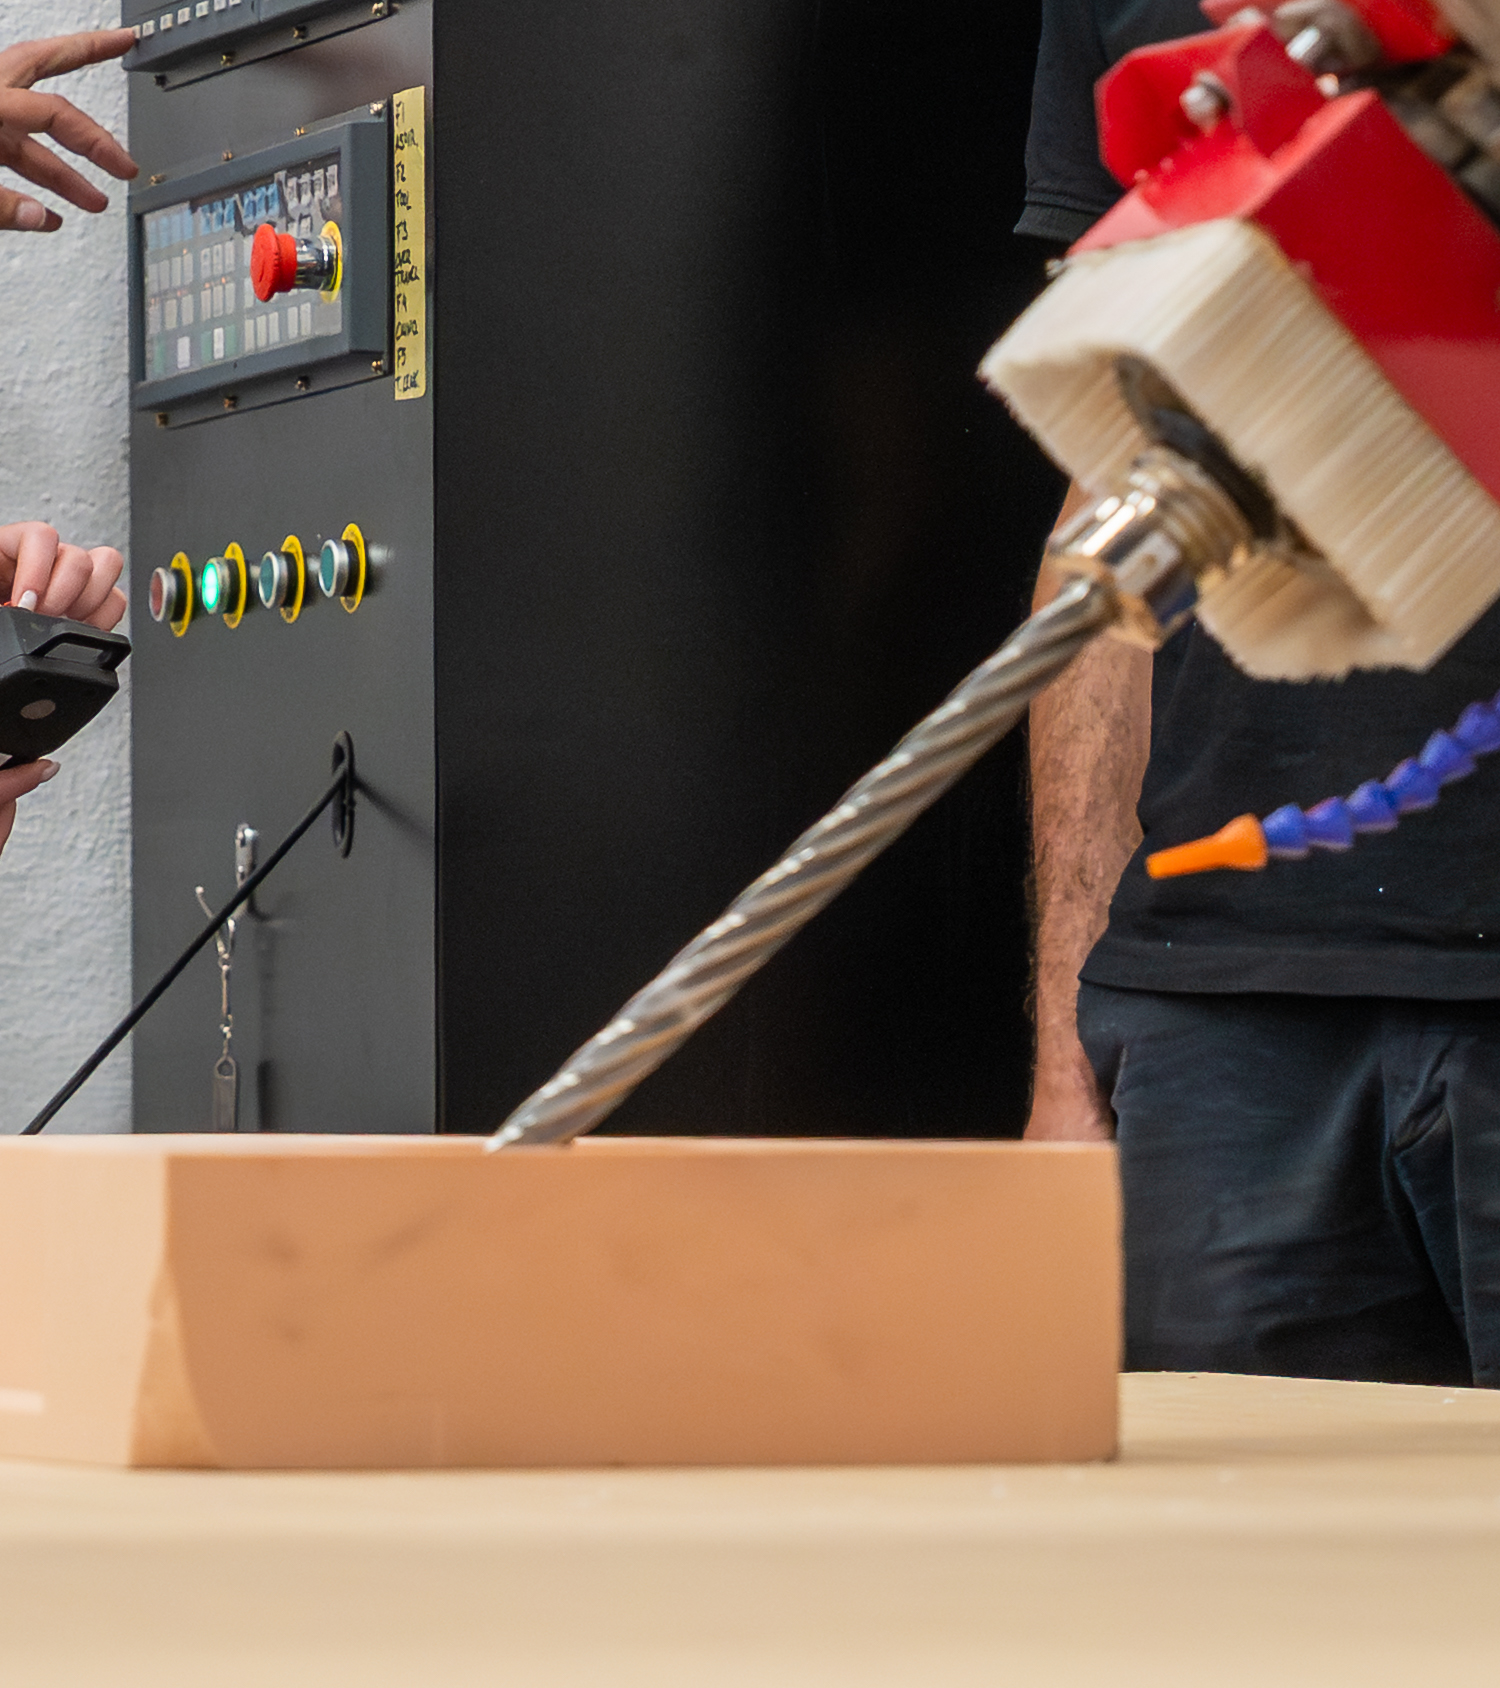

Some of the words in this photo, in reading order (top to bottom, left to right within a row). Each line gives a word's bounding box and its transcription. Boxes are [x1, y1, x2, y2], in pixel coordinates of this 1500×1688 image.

[395, 160, 407, 183] F2
[395, 219, 409, 243] F3
[396, 292, 408, 313] F4
[396, 346, 407, 368] F5
